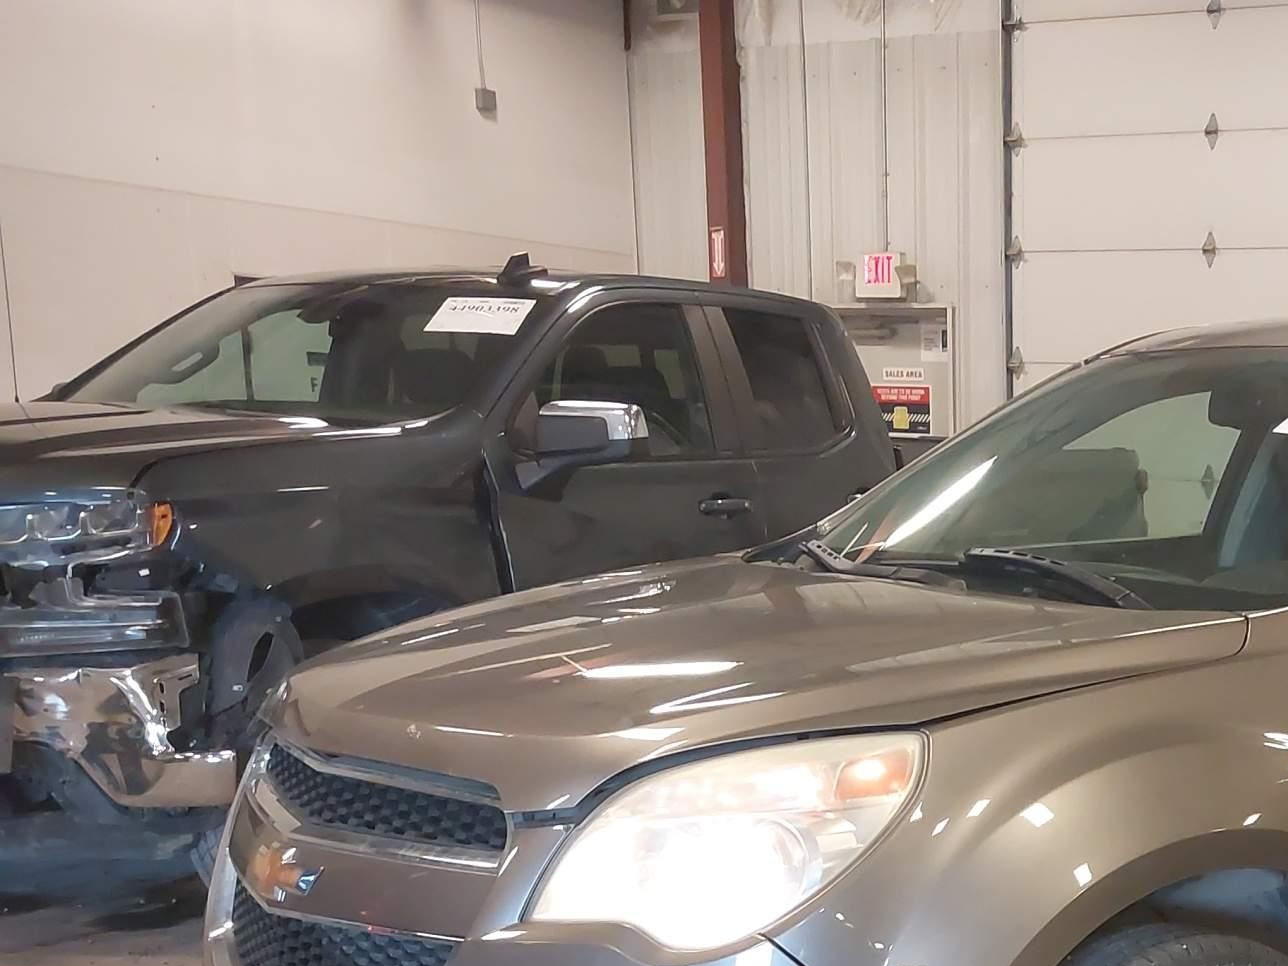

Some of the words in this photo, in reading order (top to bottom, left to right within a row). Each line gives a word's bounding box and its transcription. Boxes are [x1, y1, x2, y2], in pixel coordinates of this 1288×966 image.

[864, 255, 893, 284] EXIT
[885, 370, 904, 378] SALES
[905, 370, 922, 378] AREA
